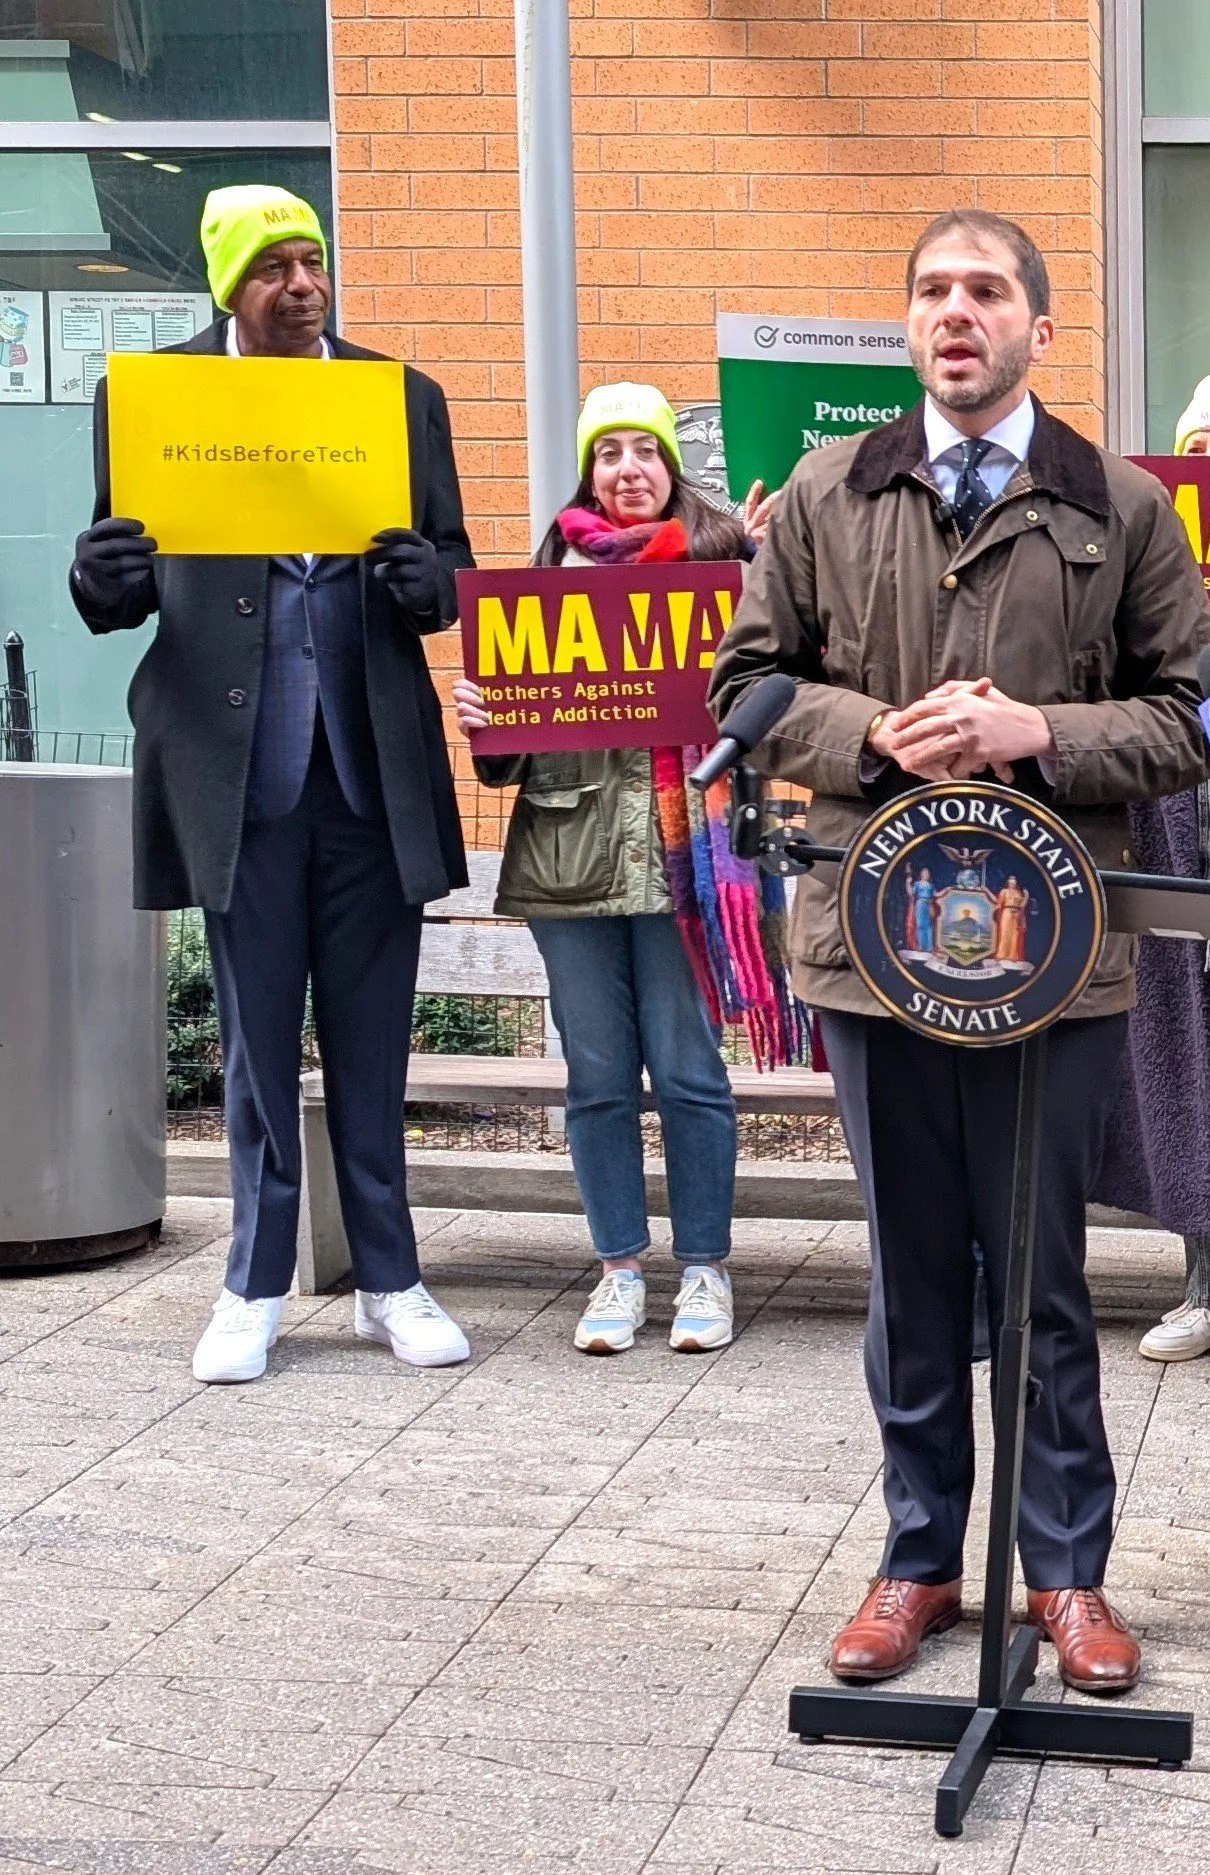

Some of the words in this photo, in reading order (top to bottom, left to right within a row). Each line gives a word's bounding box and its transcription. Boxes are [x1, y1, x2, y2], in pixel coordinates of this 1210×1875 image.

[783, 331, 854, 347] common
[858, 334, 906, 349] sense
[813, 401, 904, 423] Protect
[162, 443, 367, 463] #KidsBeforeTech
[479, 685, 563, 702] Mothers
[574, 680, 657, 701] Against
[552, 704, 659, 723] Addiction
[859, 812, 915, 880] NEW
[919, 798, 1014, 832] YORK
[1013, 818, 1084, 900] STATE
[905, 991, 1022, 1032] SENATE
